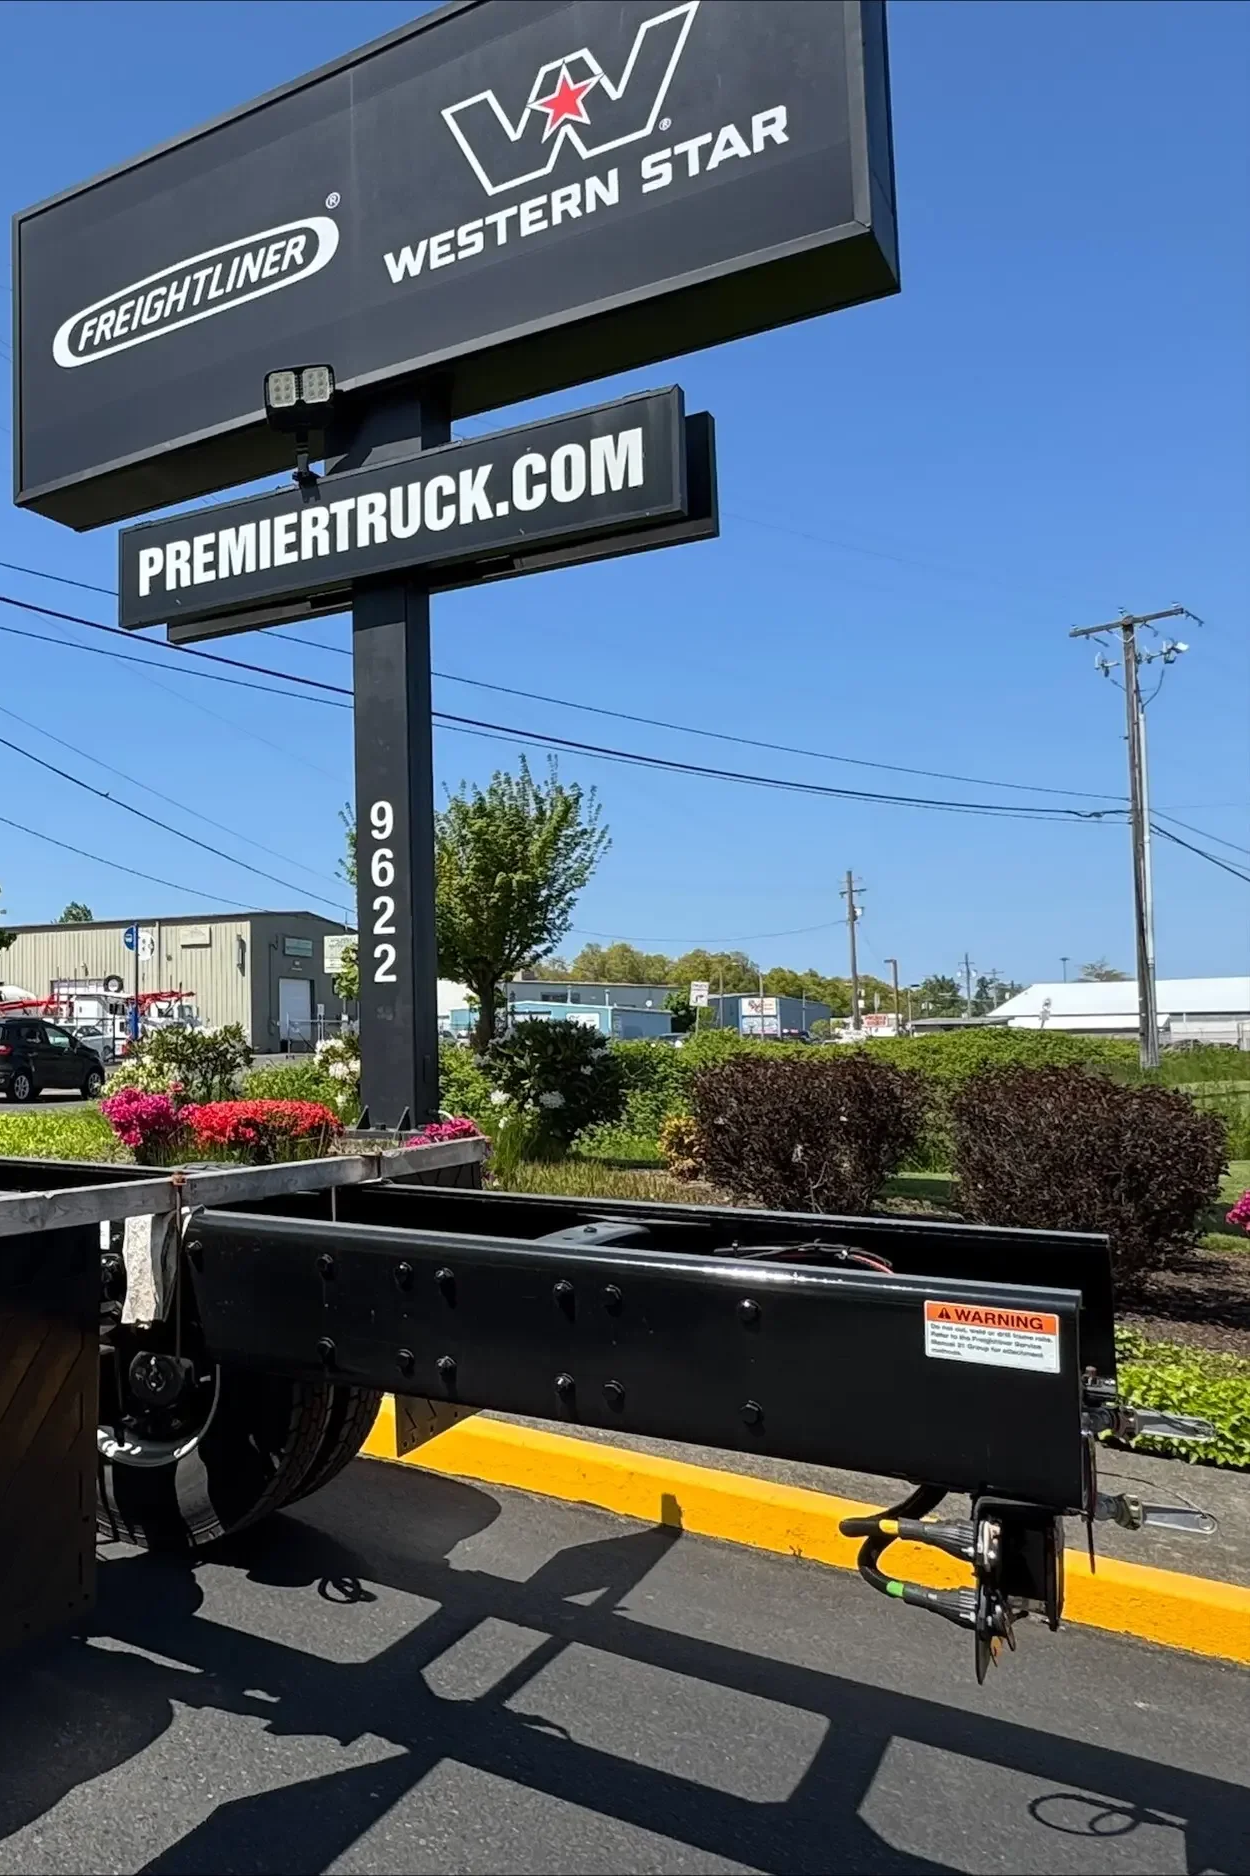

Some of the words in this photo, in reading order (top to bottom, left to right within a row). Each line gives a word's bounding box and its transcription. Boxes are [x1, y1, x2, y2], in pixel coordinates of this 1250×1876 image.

[383, 167, 619, 284] WESTERN
[640, 104, 790, 194] STAR
[77, 234, 307, 352] FREIGHTLINER
[138, 427, 645, 597] PREMIERTRUCK.COM
[954, 1308, 1044, 1330] WARNING
[967, 1343, 989, 1353] Group
[1014, 1341, 1042, 1350] Service
